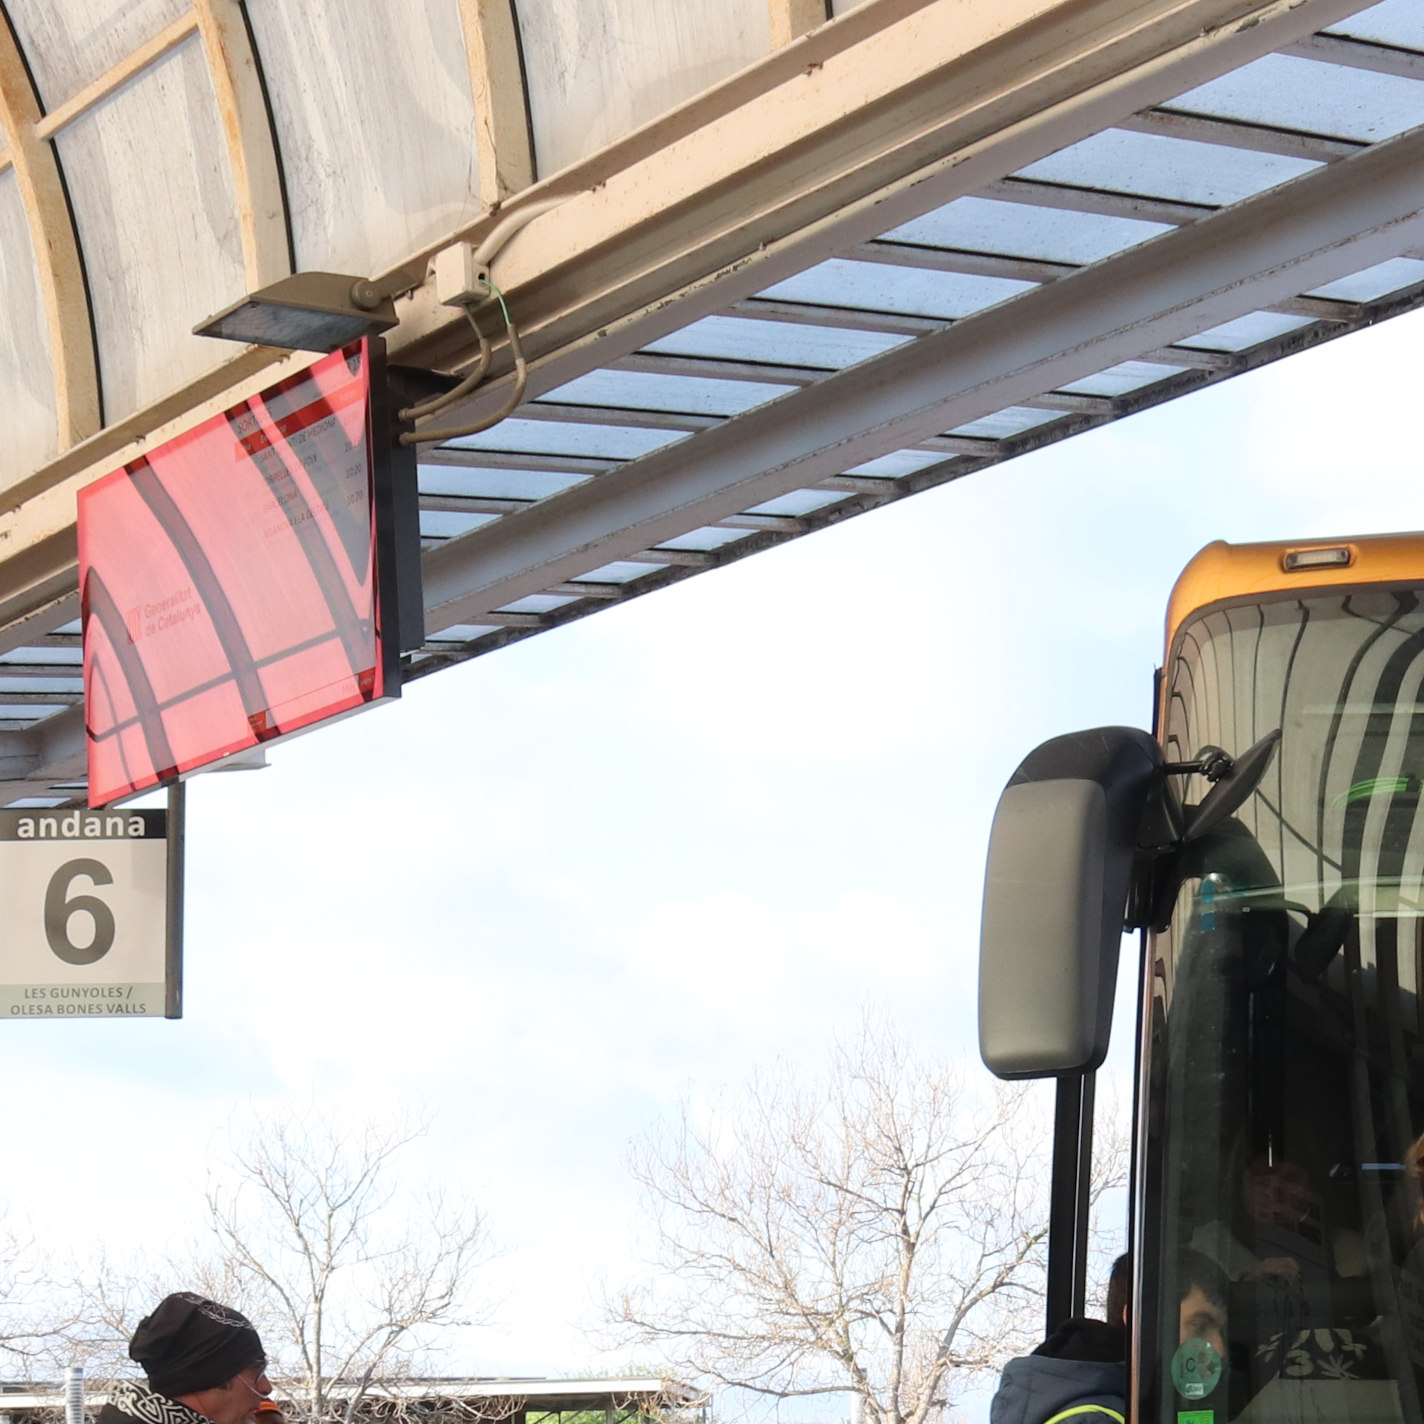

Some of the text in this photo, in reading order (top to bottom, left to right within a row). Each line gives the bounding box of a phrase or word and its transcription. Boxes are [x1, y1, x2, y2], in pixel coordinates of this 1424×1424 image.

[17, 811, 146, 838] andana
[44, 857, 116, 966] 6
[25, 988, 46, 999] LES
[50, 986, 123, 999] GUNYOLES
[10, 1003, 146, 1016] OLESA BONES VALLS
